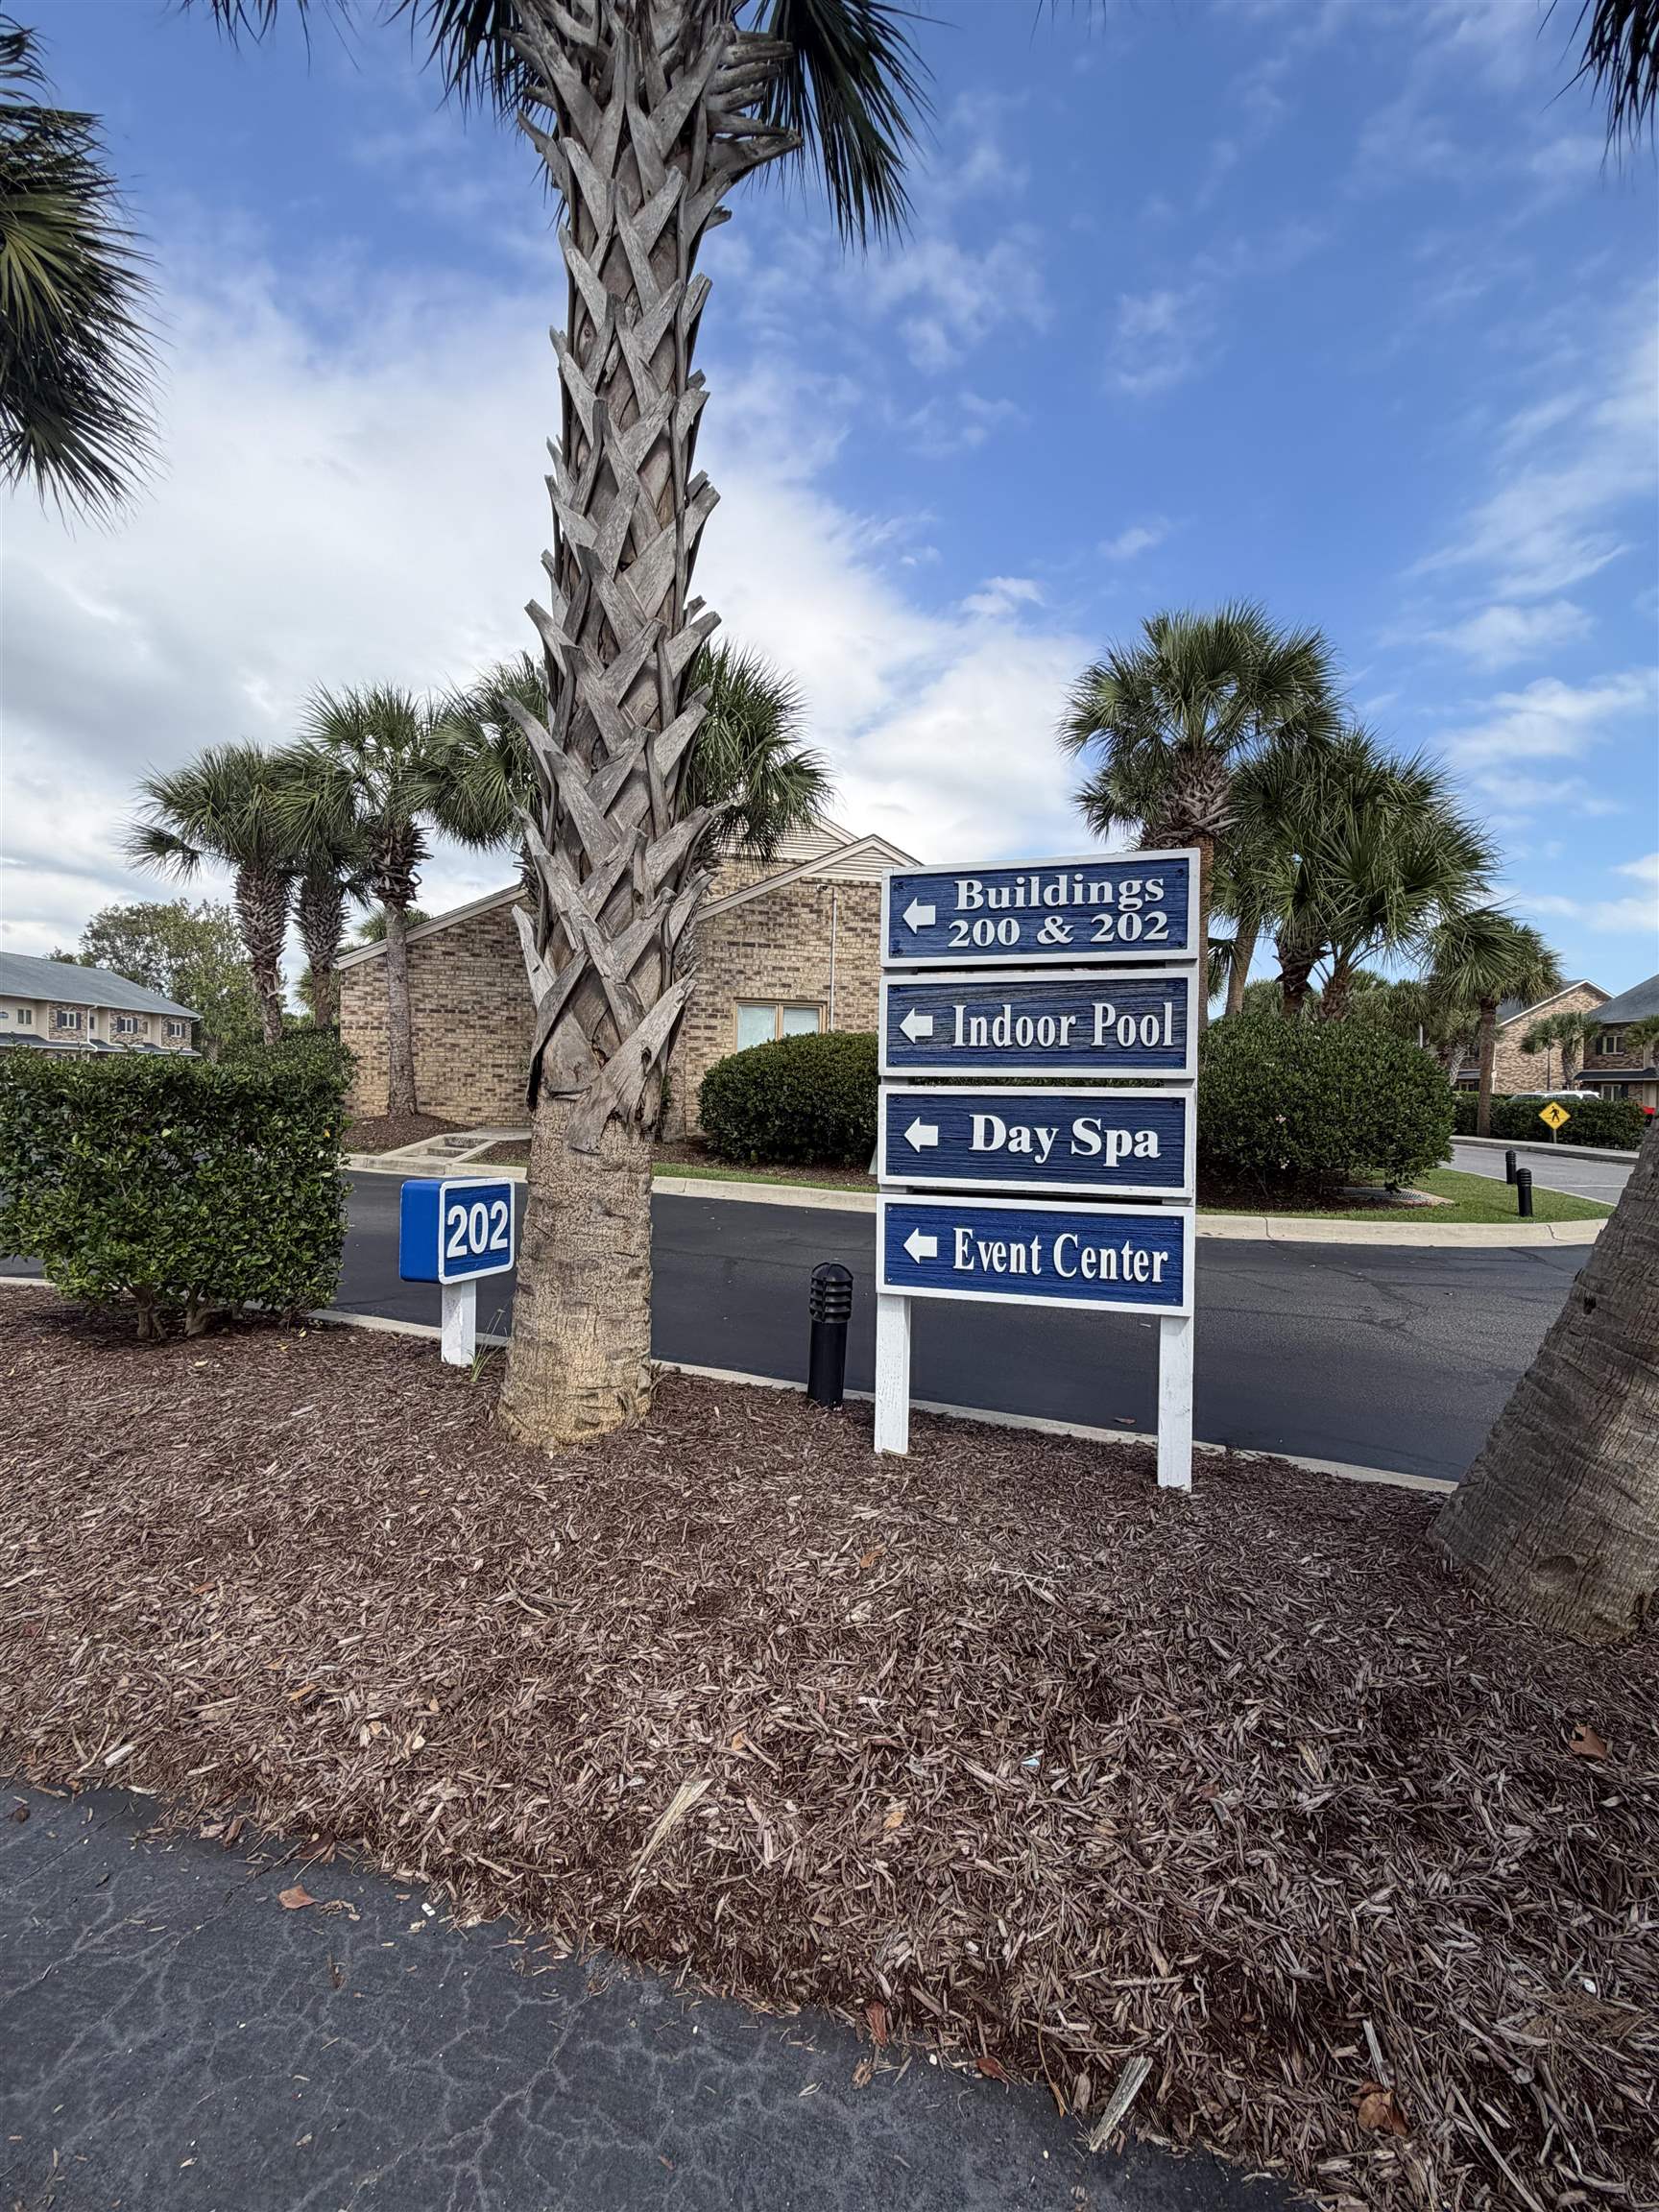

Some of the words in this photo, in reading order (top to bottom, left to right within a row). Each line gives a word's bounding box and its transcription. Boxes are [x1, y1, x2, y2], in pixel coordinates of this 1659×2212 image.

[953, 872, 1166, 913] Buildings
[948, 918, 1021, 948] 200
[1036, 915, 1074, 945] &
[1090, 911, 1169, 942] 202
[951, 1003, 1076, 1047] Indoor
[1091, 1001, 1174, 1047] Pool
[968, 1114, 1060, 1164] Day
[1070, 1118, 1162, 1167] Spa
[446, 1200, 509, 1259] 202
[952, 1227, 1043, 1275] Event
[1053, 1233, 1168, 1283] Center
